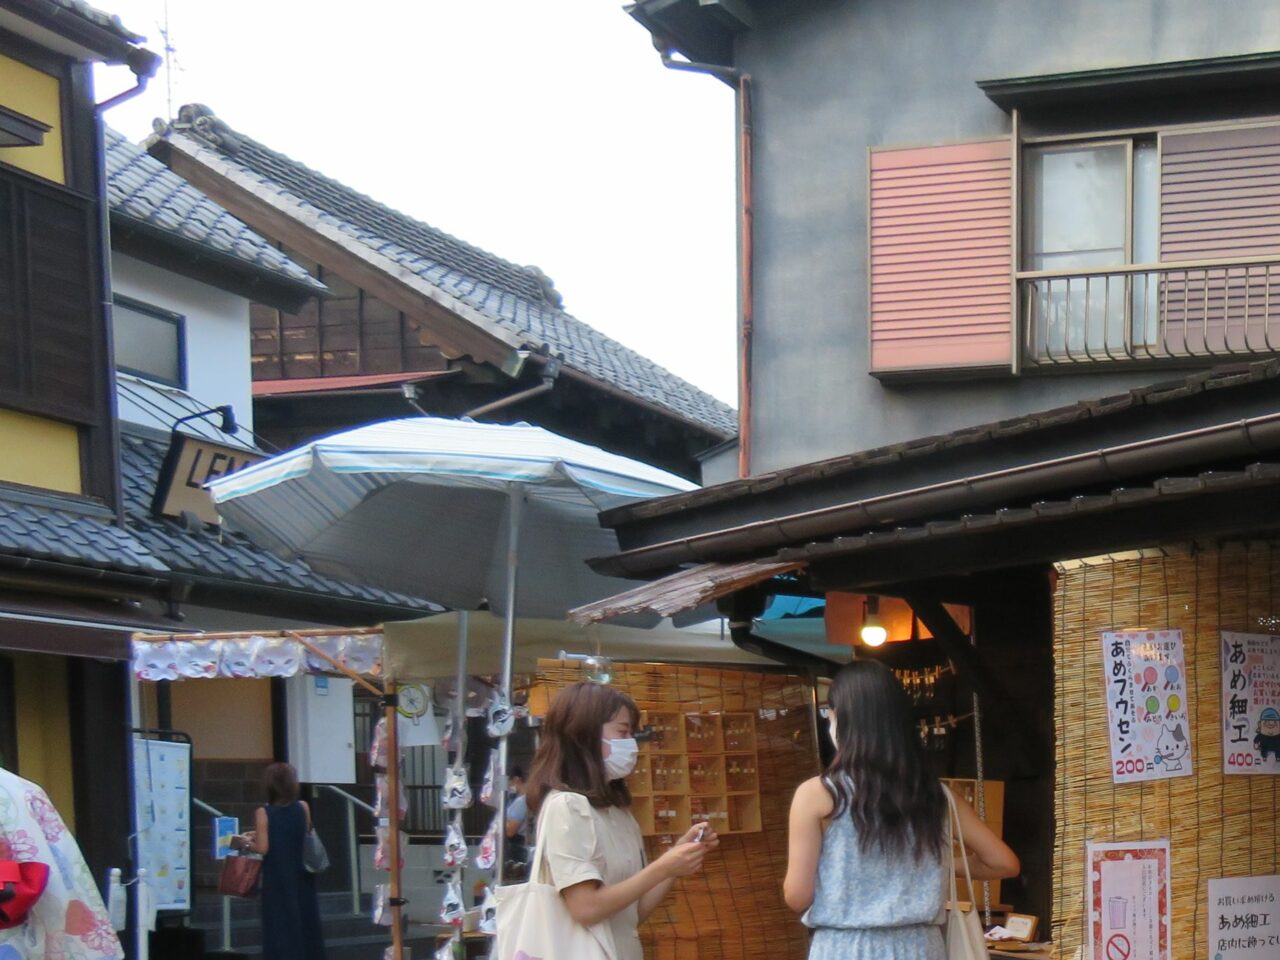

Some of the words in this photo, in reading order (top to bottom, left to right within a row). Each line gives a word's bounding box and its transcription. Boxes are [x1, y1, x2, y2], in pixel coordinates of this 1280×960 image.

[1110, 639, 1132, 754] あめフウセン
[1228, 640, 1249, 744] あめ細工
[1218, 913, 1271, 931] あめ細工
